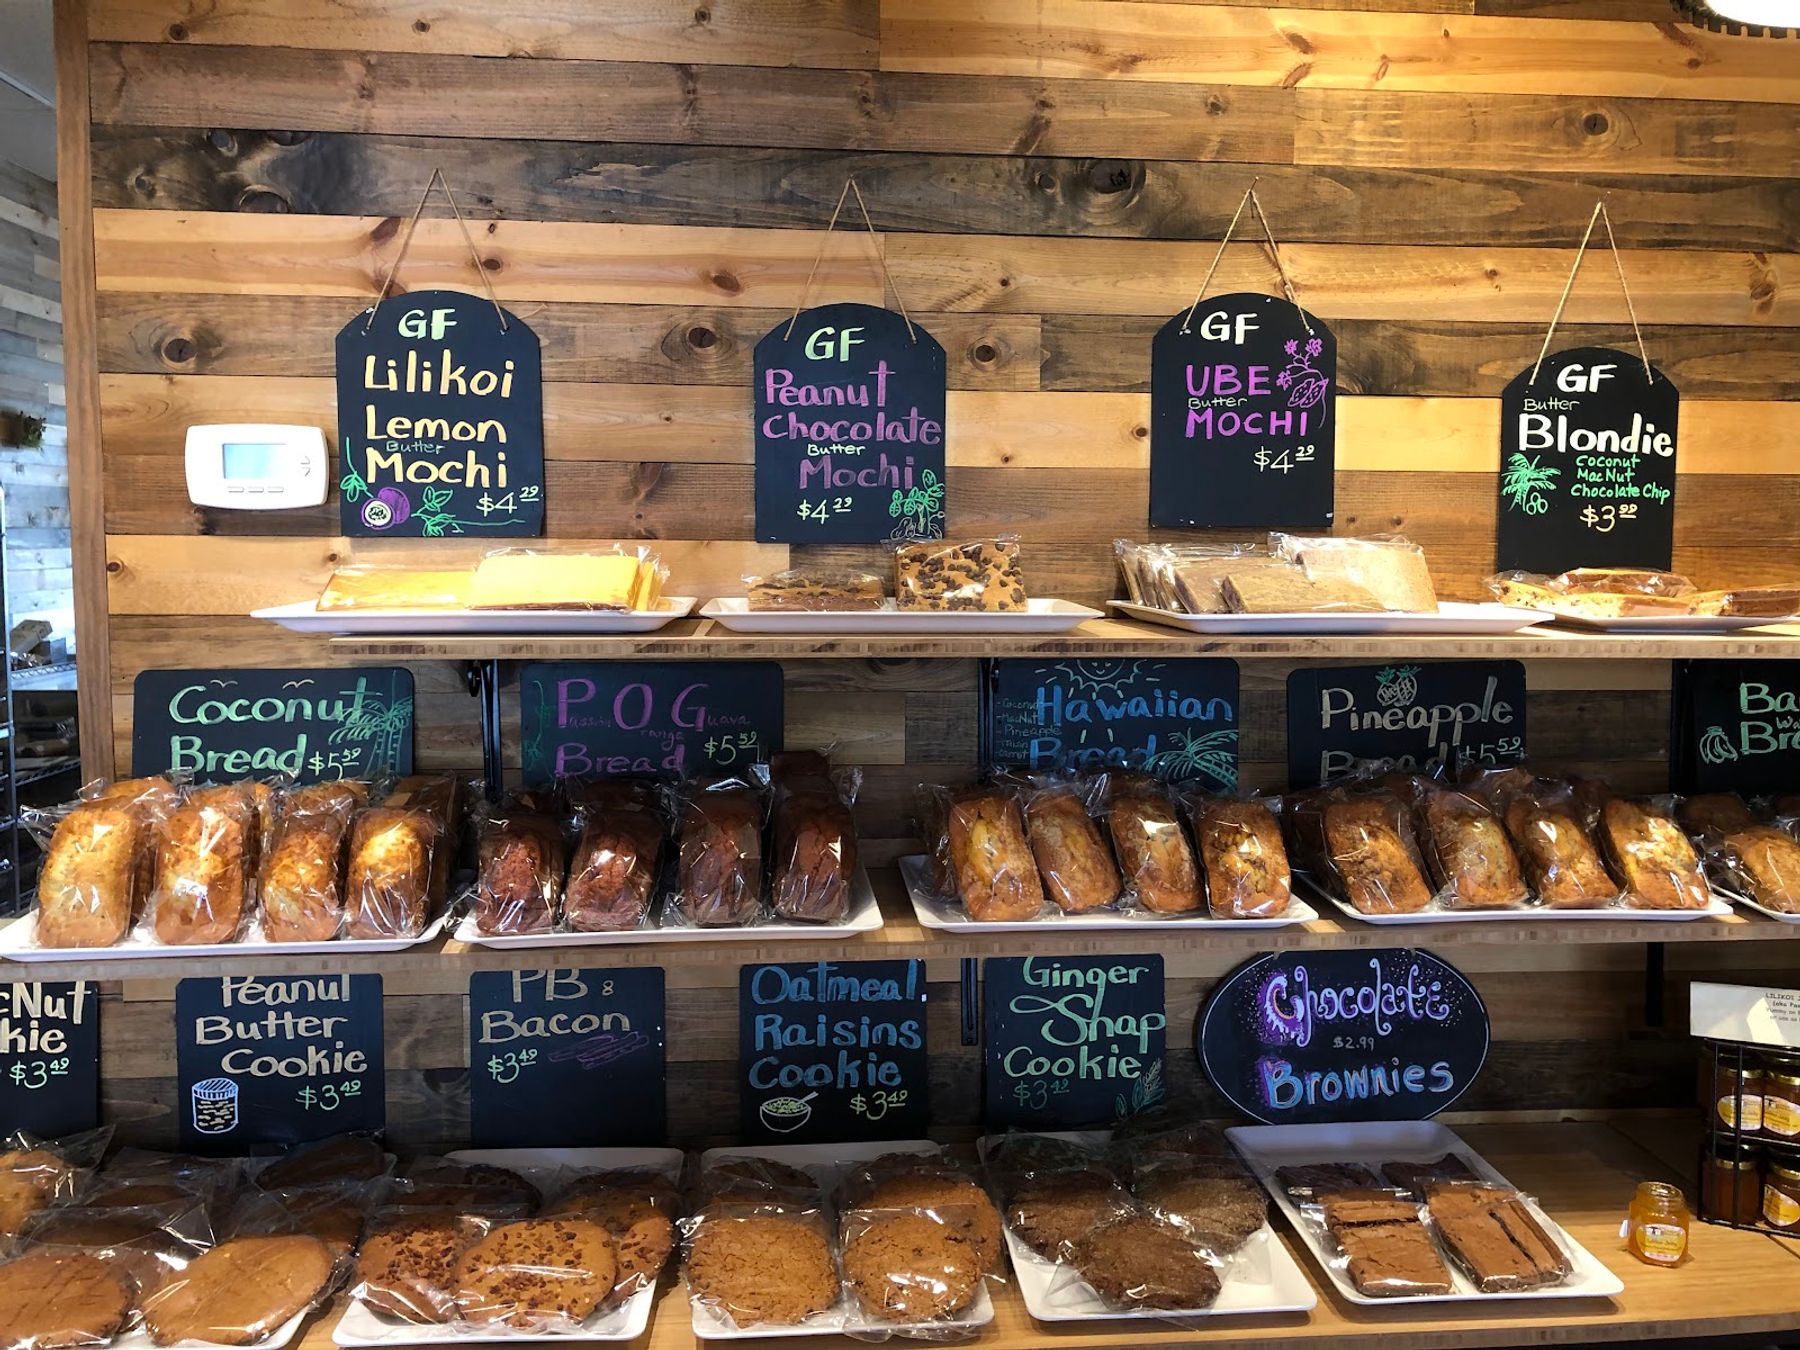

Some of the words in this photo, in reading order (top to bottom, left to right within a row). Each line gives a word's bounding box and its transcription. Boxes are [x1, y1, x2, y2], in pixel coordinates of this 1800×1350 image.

[398, 309, 457, 340] GF
[1201, 311, 1260, 344] GF
[805, 326, 864, 362] GF
[365, 349, 514, 398] Lilikoi
[765, 360, 896, 407] Peanut
[1186, 364, 1271, 396] UBE
[1557, 364, 1617, 393] GF
[1188, 396, 1247, 409] Butter
[1523, 397, 1580, 411] Butter
[366, 404, 507, 443] Lemon
[763, 407, 941, 444] Chocolate
[1185, 408, 1309, 439] MOCHI
[1519, 413, 1673, 457] Blondie
[386, 441, 445, 454] Butter
[807, 444, 866, 456] Butter
[1576, 454, 1641, 468] Coconut
[366, 447, 507, 488] Mochi
[800, 452, 914, 489] Mochi
[1577, 468, 1603, 482] Mac
[1606, 468, 1635, 482] Nut
[1571, 482, 1640, 498] Chocolate
[1643, 482, 1670, 504] Chip
[169, 676, 383, 725] Coconut
[1036, 685, 1233, 726] Hawaiian
[1321, 675, 1513, 747] Pineapple
[169, 734, 307, 773] Bread
[553, 742, 685, 778] Bread
[1320, 741, 1448, 786] Bad
[512, 969, 589, 1003] PB
[752, 960, 918, 1004] Oatmeal
[1022, 956, 1150, 1022] Ginger
[1265, 958, 1450, 1047] Chocolate
[196, 1010, 349, 1045] Butter
[478, 1010, 631, 1044] Bacon
[754, 1013, 922, 1051] Raisins
[1009, 993, 1166, 1054] Snap
[221, 1041, 368, 1078] Cookie
[1333, 1036, 1375, 1050] $2.99
[749, 1049, 902, 1090] Cookie
[1003, 1044, 1142, 1080] Cookie
[1263, 1057, 1454, 1109] Brownies
